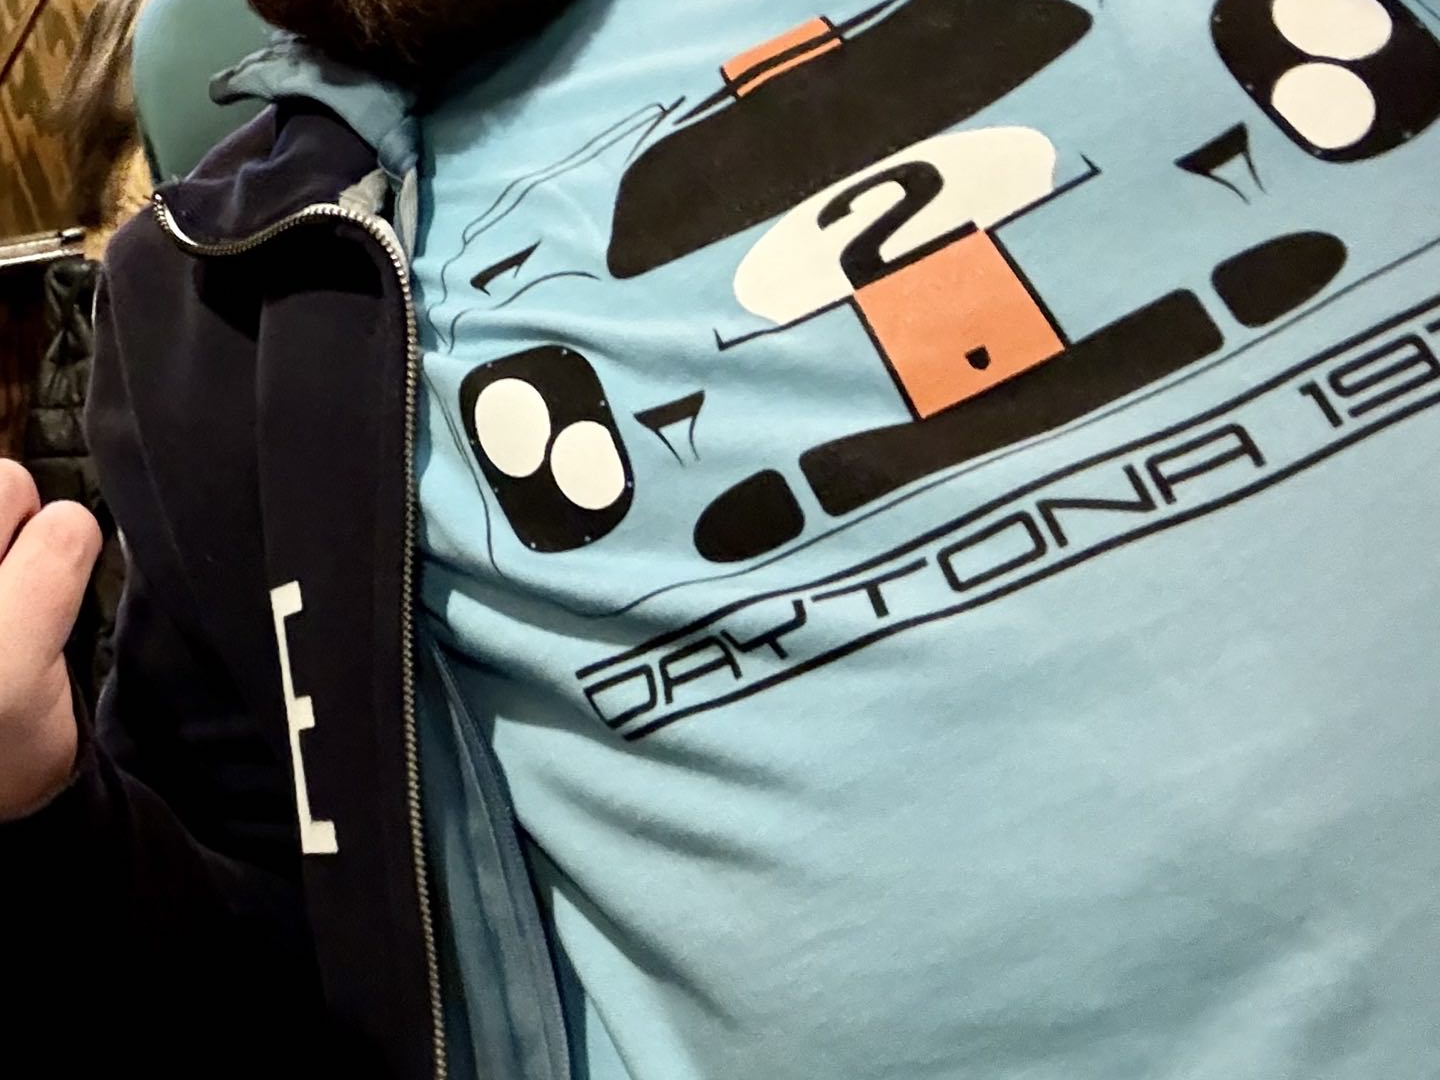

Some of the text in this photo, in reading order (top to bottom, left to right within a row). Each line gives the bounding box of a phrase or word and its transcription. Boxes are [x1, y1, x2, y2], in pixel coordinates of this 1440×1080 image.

[817, 161, 978, 290] 2
[582, 319, 1440, 729] DAYTONA 19
